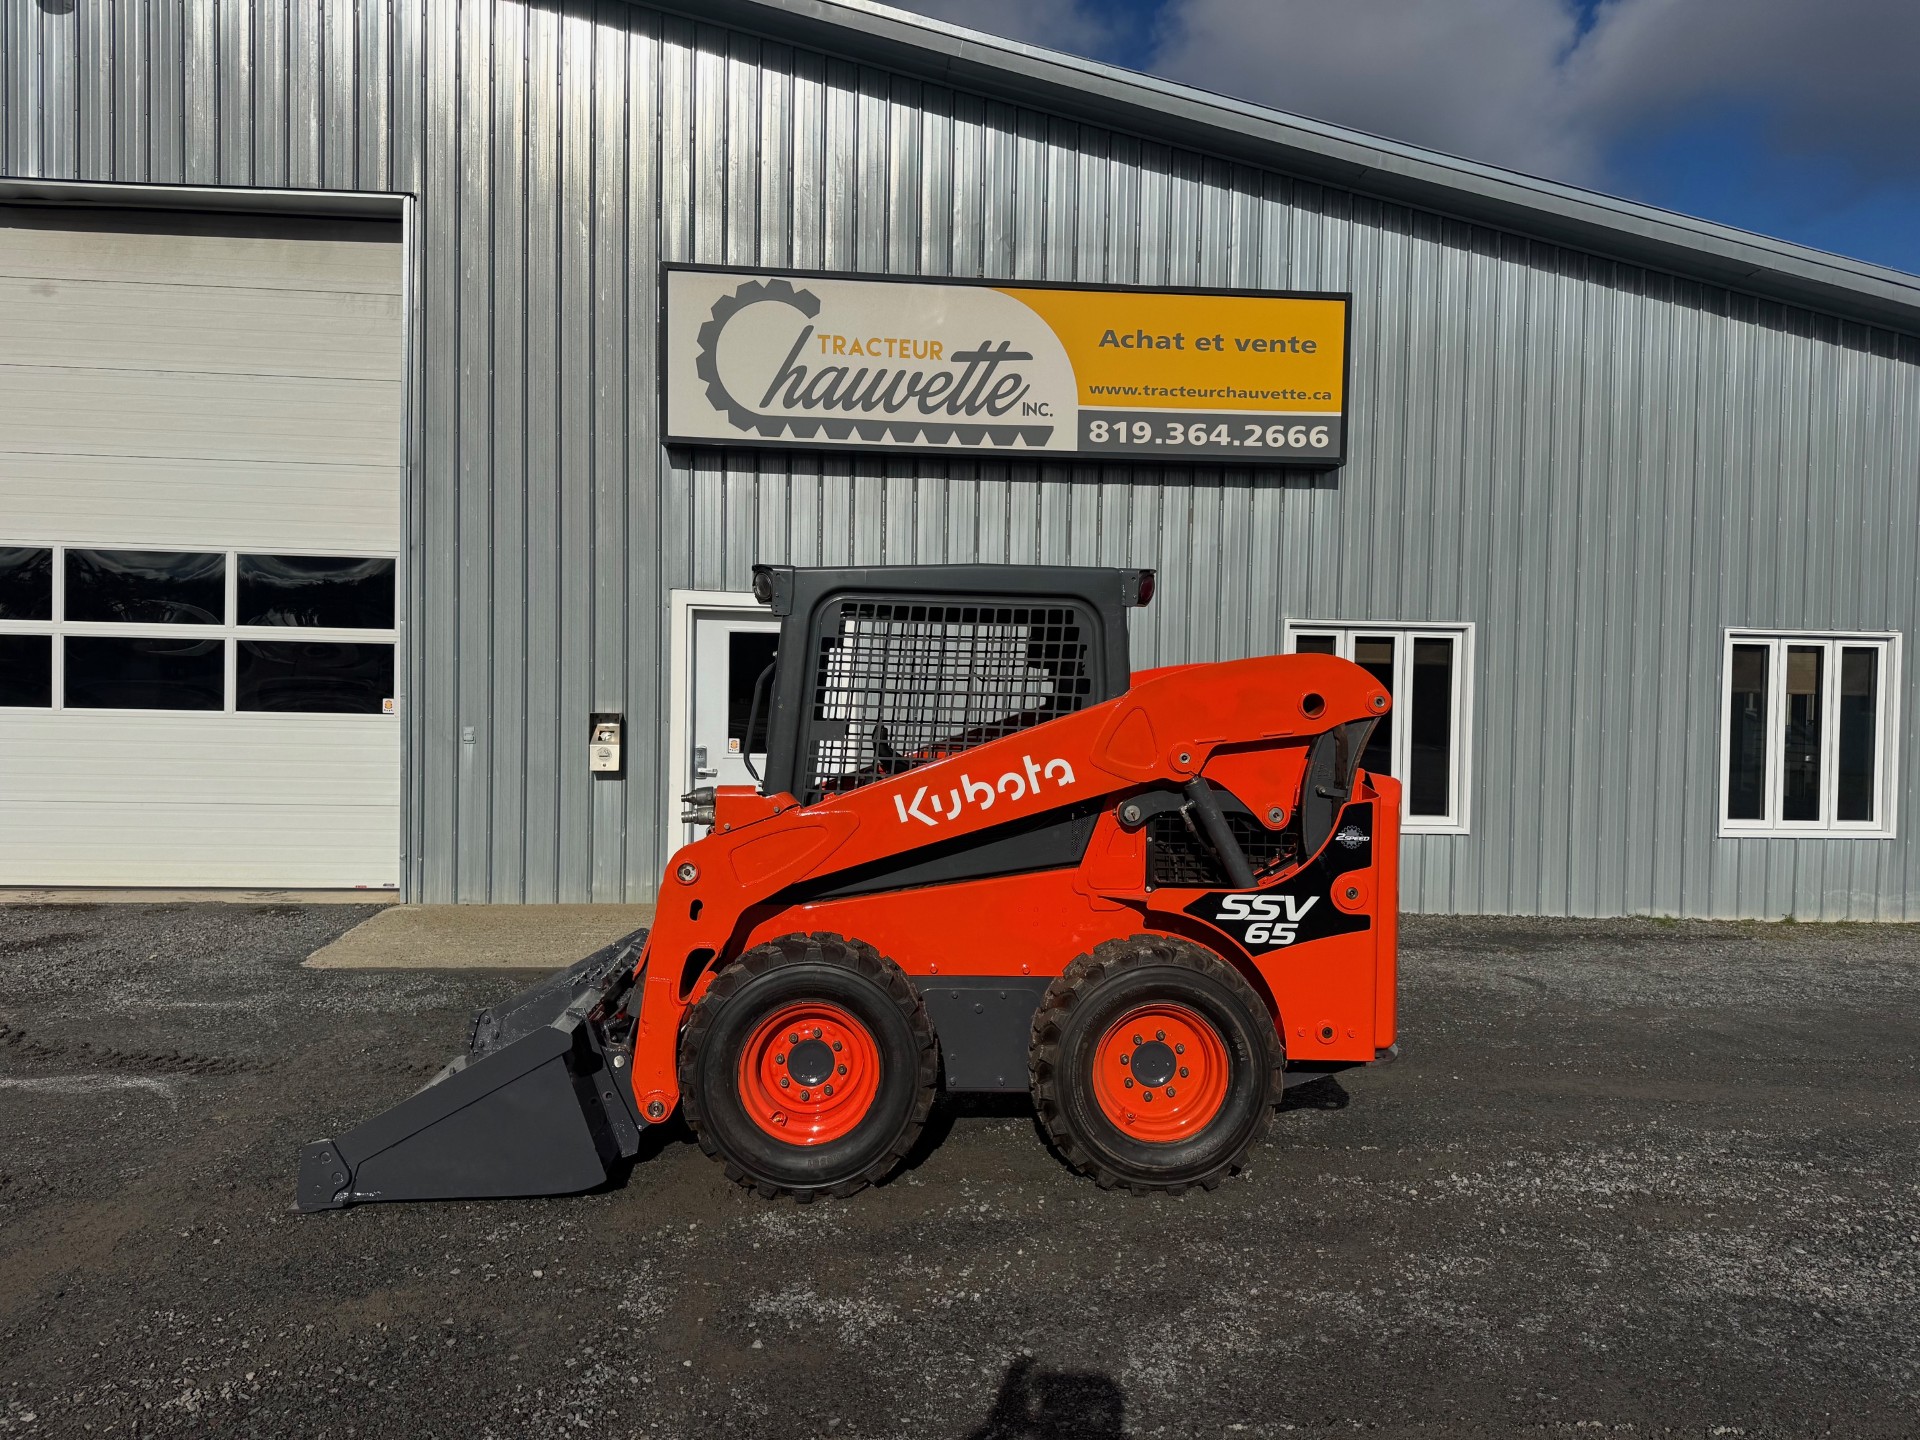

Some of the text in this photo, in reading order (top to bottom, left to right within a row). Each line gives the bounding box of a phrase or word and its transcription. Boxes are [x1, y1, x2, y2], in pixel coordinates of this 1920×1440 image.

[696, 278, 1054, 432] Chauvette INC.
[817, 334, 943, 361] TRACTEUR
[1099, 329, 1318, 354] Achat et vente
[1089, 385, 1332, 401] www.tracteurchauvette.ca
[1089, 420, 1330, 449] 819.364.2666
[893, 755, 1076, 827] Kubota
[1215, 894, 1321, 922] SSV
[1244, 922, 1299, 945] 65
